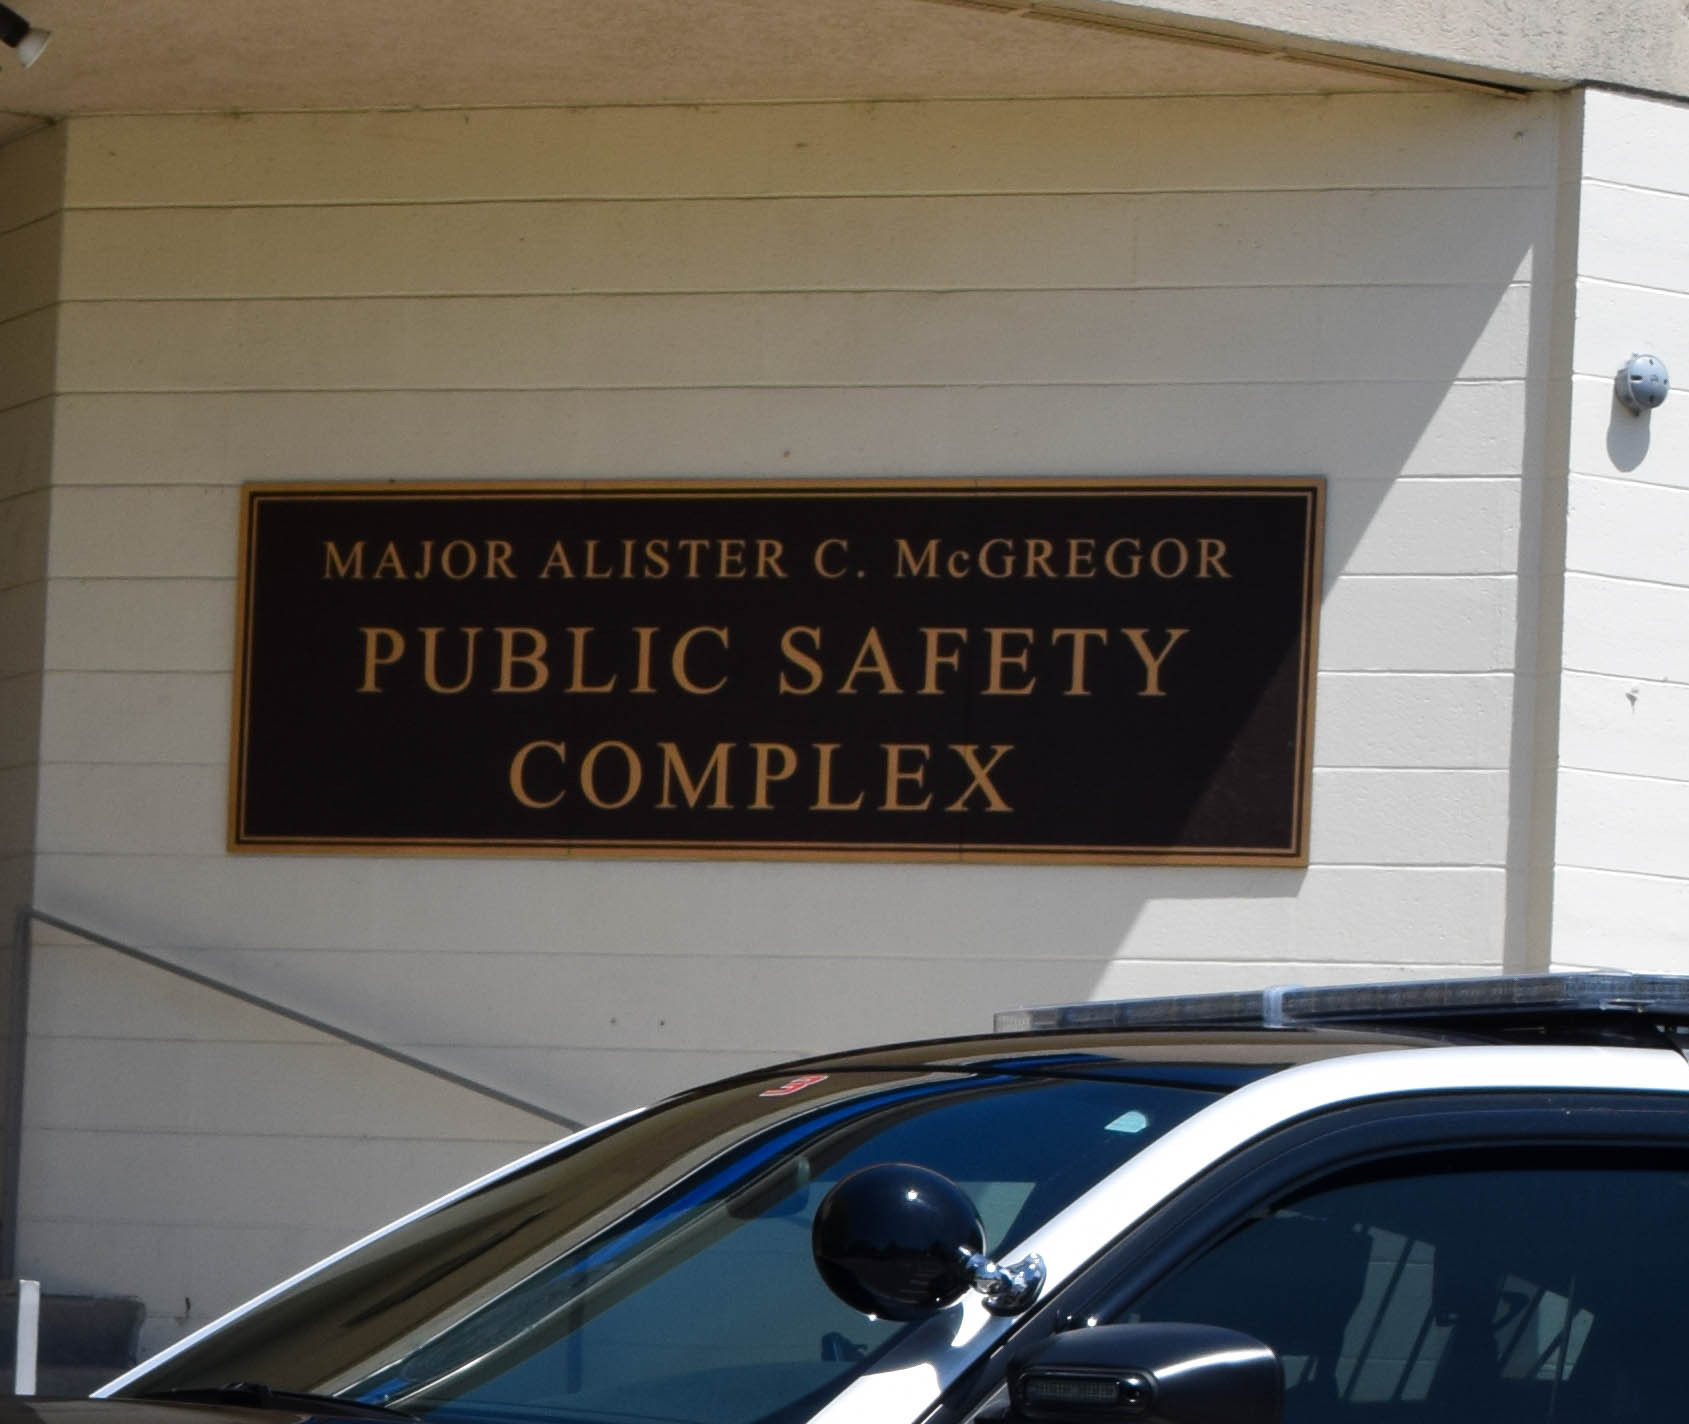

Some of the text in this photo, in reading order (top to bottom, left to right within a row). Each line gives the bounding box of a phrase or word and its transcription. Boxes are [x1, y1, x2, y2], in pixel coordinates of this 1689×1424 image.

[321, 538, 1231, 579] MAJOR ALISTER C. McGREGOR
[357, 626, 1191, 697] PUBLIC SAFETY
[509, 740, 1015, 812] COMPLEX
